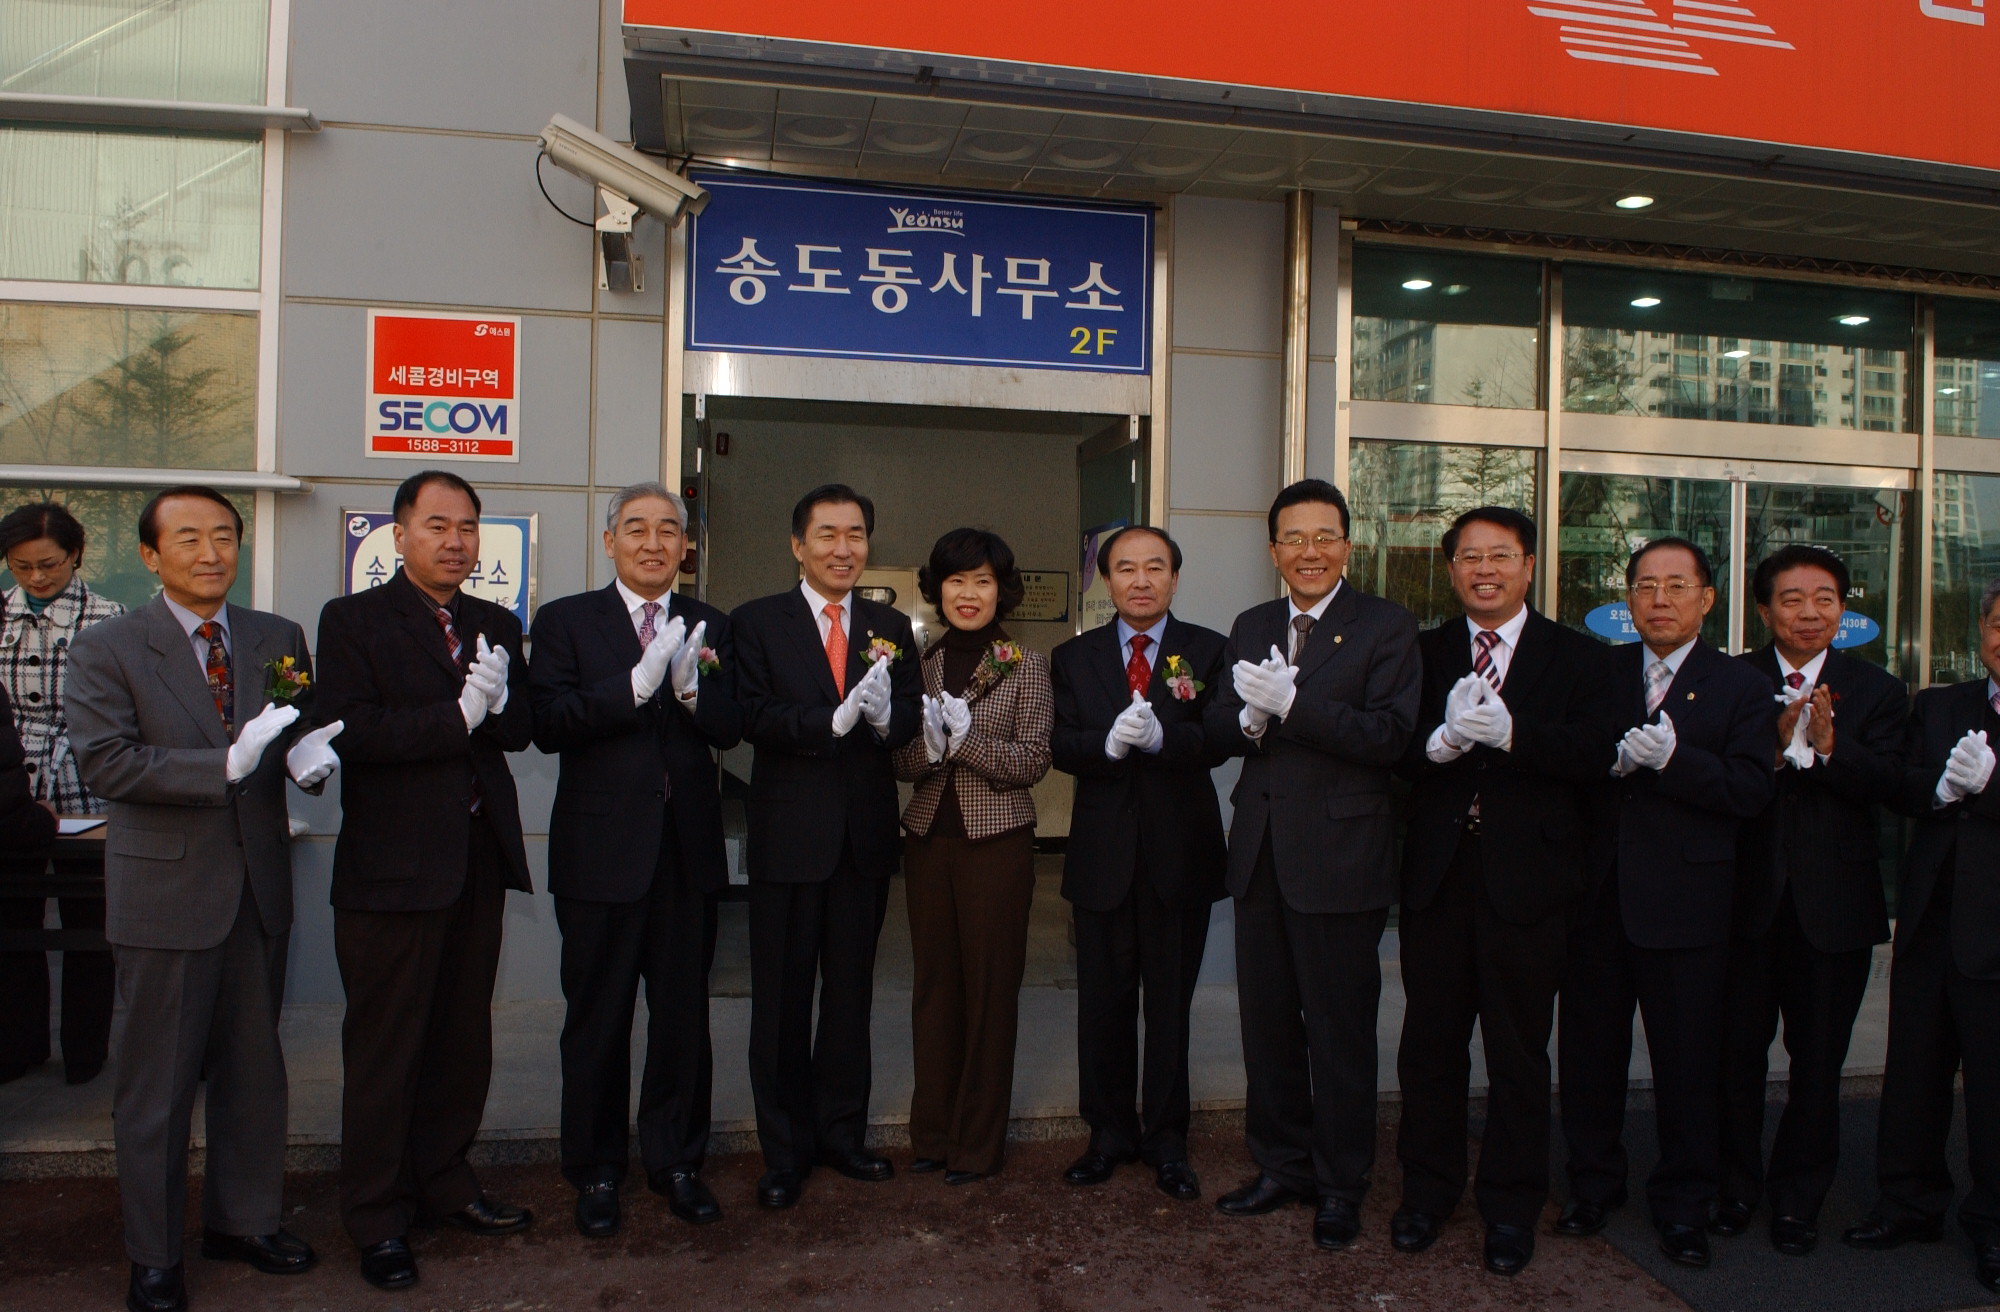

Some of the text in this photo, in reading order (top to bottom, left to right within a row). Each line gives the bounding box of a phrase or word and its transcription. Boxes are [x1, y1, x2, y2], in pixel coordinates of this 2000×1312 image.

[889, 206, 964, 229] Yeonsu
[714, 236, 1125, 320] 송도동사무소
[1069, 326, 1118, 356] 2F
[388, 365, 499, 389] 세콤경비구역
[379, 400, 508, 435] SECOM
[407, 438, 479, 453] 1588-3112
